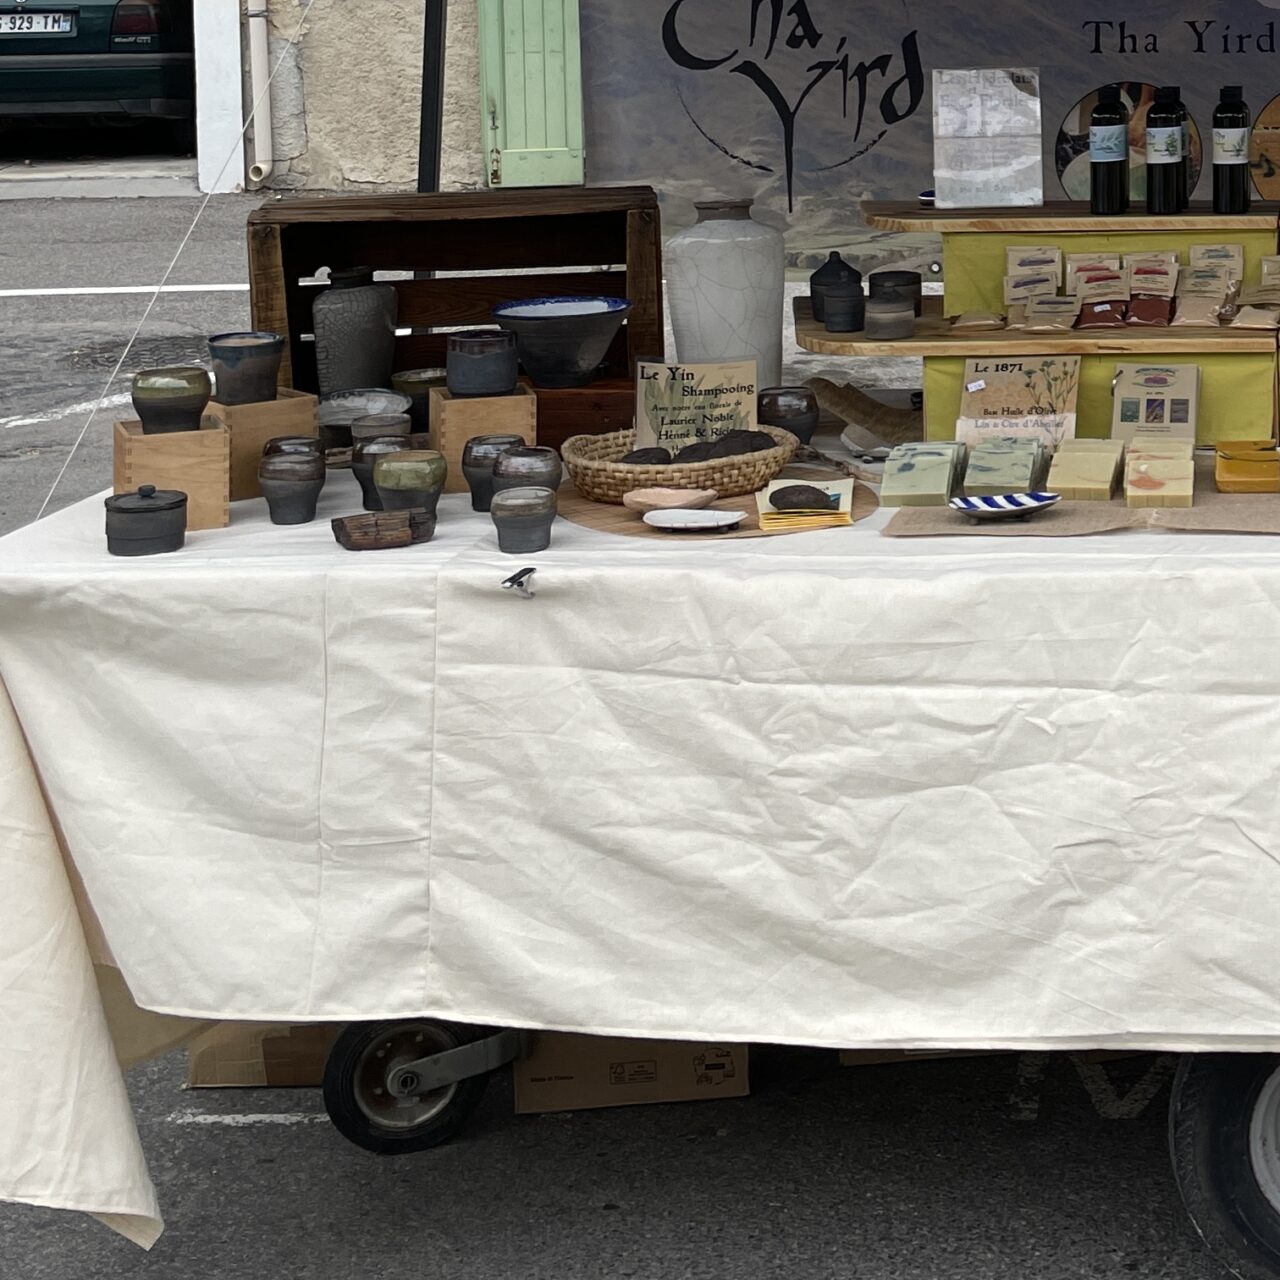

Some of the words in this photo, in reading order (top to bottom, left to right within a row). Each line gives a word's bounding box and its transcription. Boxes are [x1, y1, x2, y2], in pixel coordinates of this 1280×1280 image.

[1082, 19, 1161, 55] Tha
[1182, 18, 1277, 56] Yird
[640, 365, 660, 381] Le
[667, 365, 695, 381] Yin
[974, 362, 990, 373] Le
[994, 362, 1024, 374] 1871
[682, 384, 755, 399] Shampooing
[661, 416, 696, 426] Laurier
[702, 413, 735, 424] Noble
[695, 427, 706, 438] &
